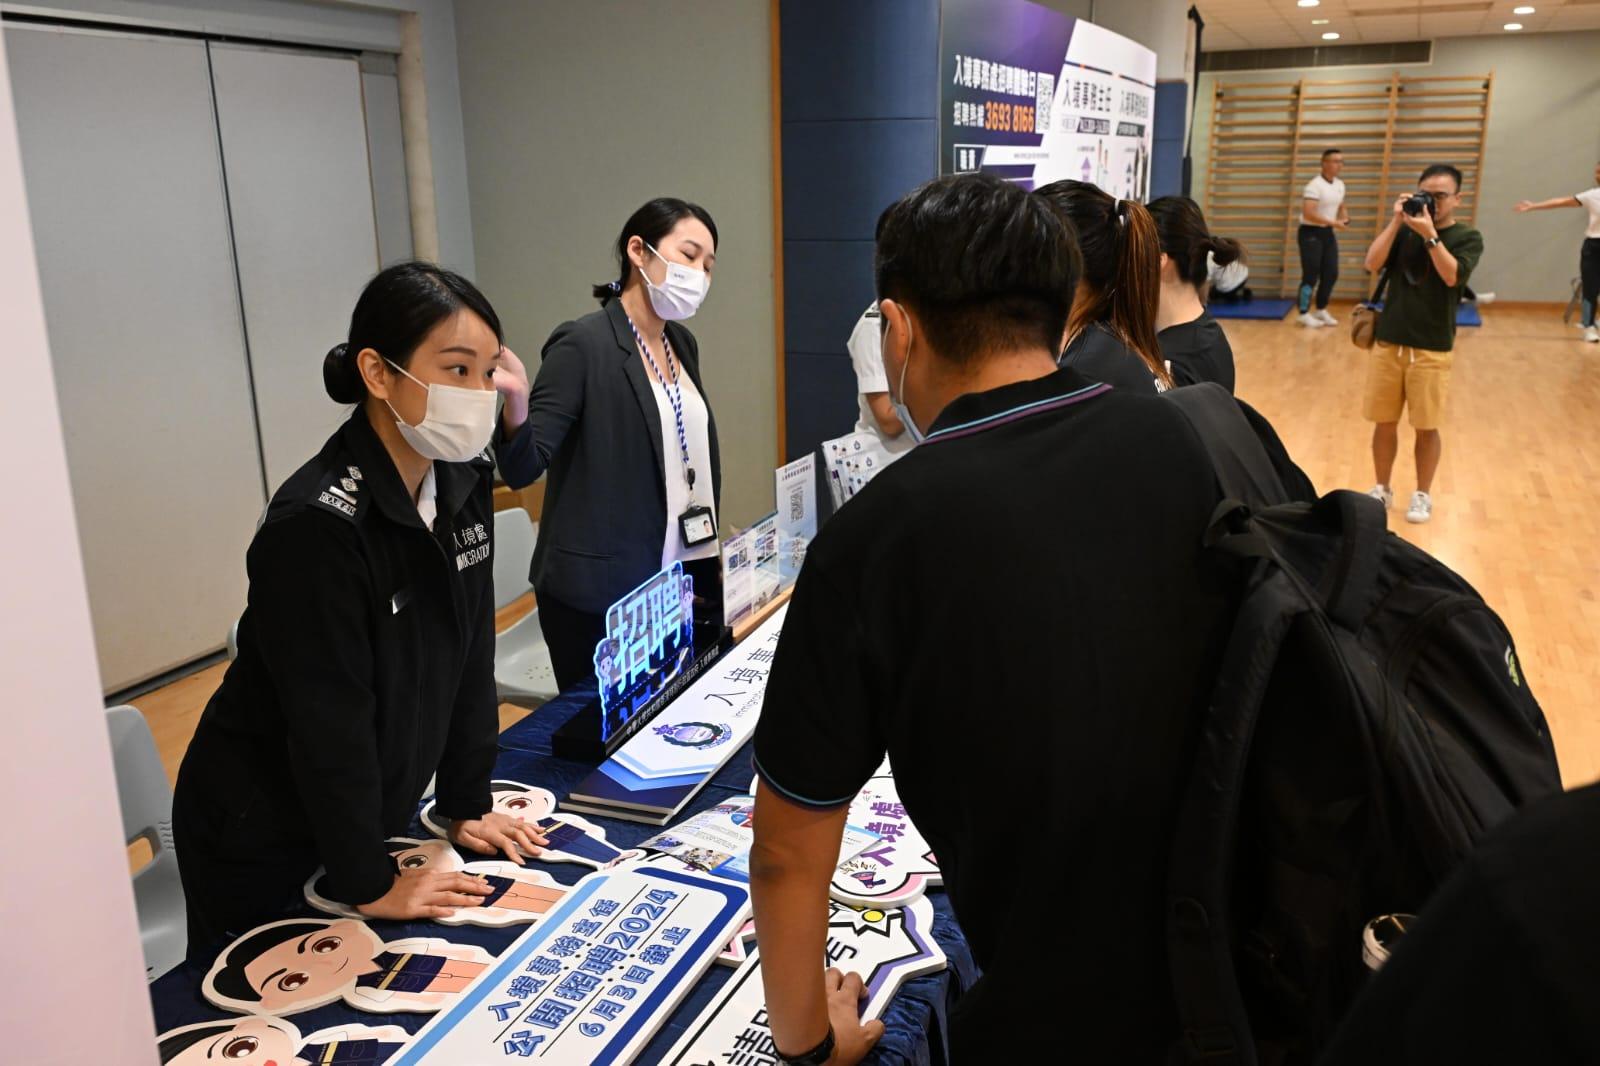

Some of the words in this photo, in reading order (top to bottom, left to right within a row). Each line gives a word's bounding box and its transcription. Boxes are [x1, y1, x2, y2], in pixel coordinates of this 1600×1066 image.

[985, 102, 1011, 131] 3693
[1013, 105, 1034, 133] 8166
[453, 523, 487, 550] 入境處
[613, 566, 681, 695] 招聘
[489, 899, 620, 1022] 入境事務主任
[579, 926, 691, 1037] 6月3日截止
